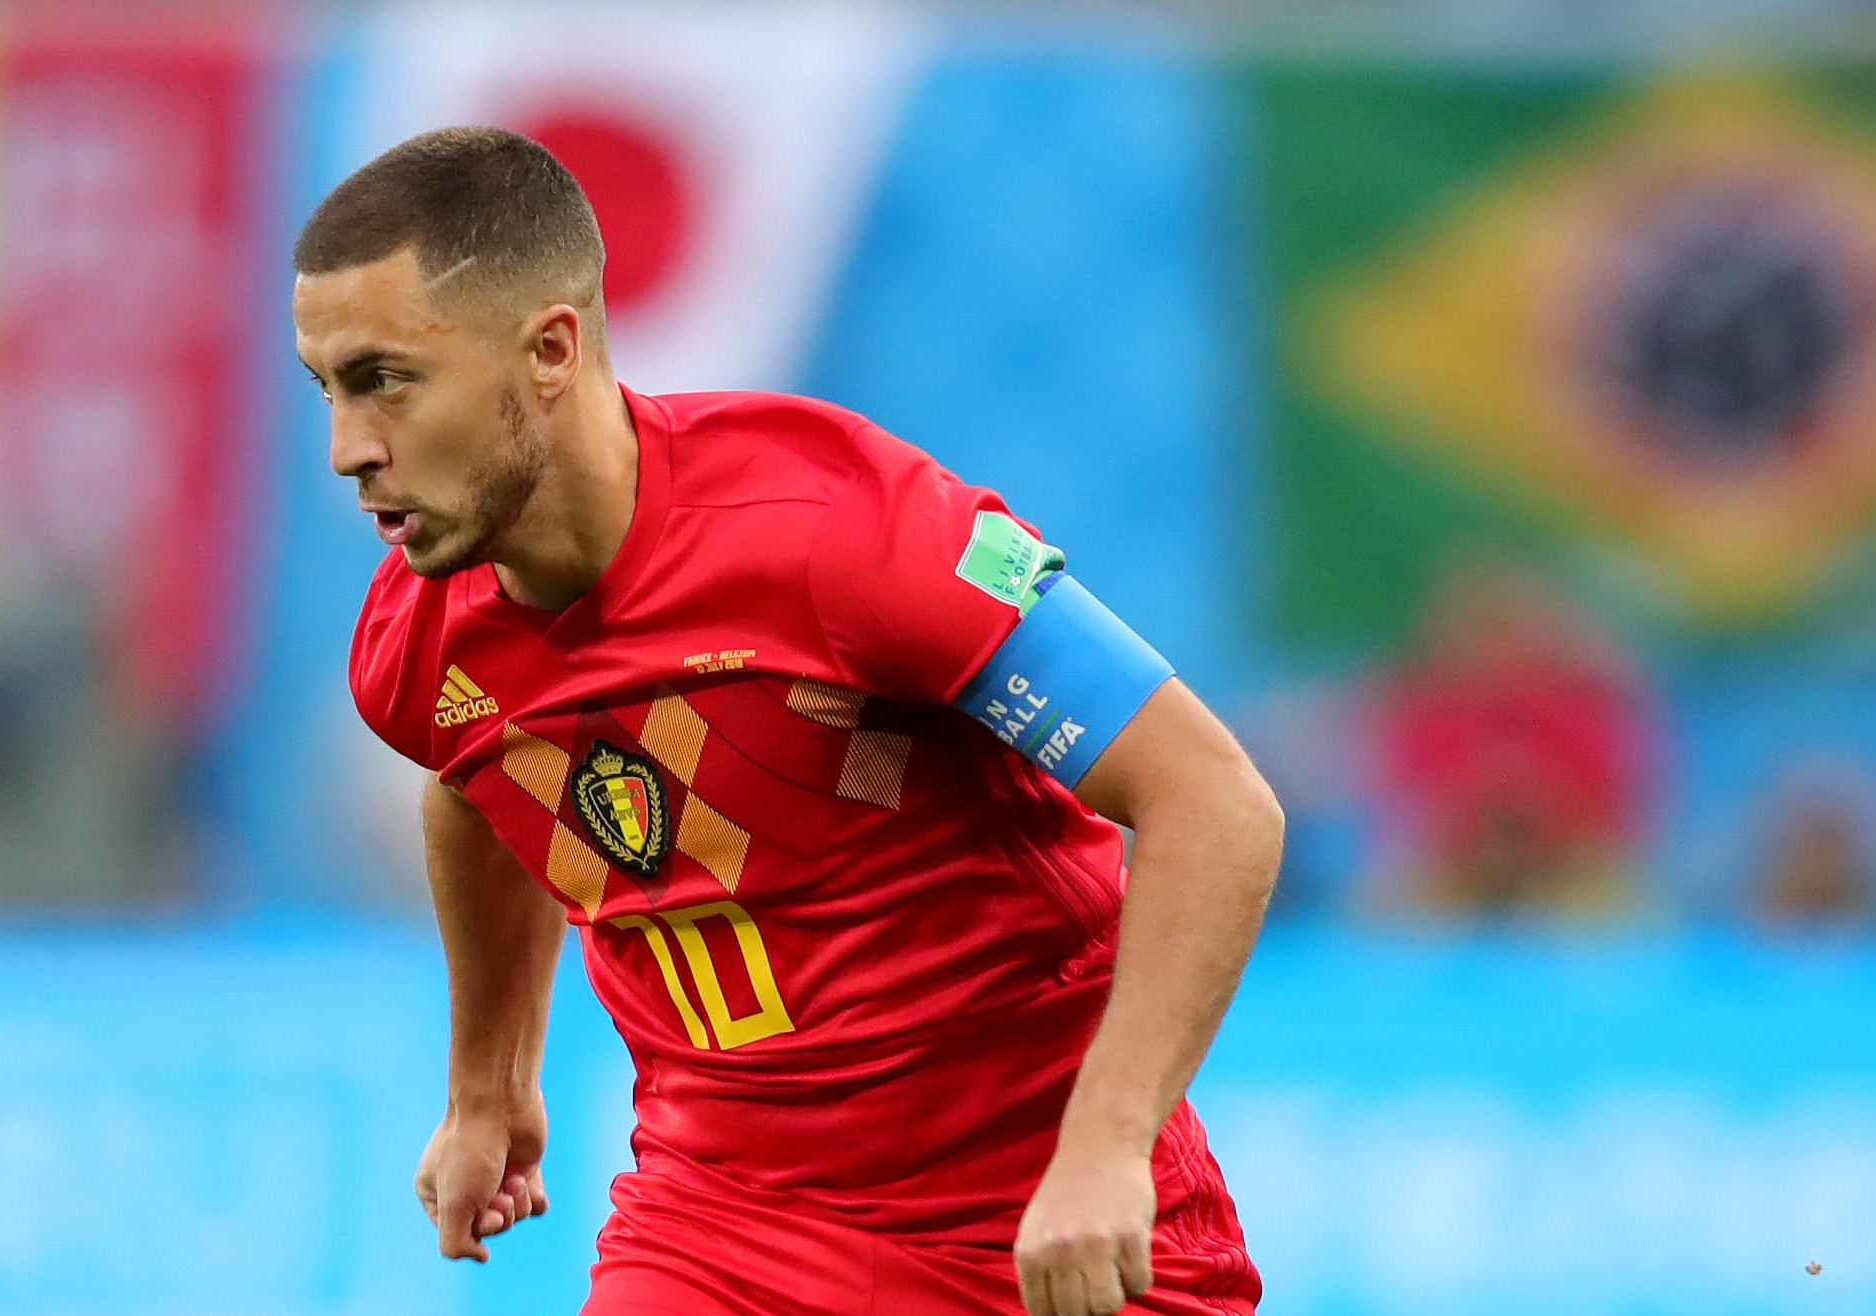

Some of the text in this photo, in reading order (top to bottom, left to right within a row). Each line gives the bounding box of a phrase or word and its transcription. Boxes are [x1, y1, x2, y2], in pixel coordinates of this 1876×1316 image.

[434, 696, 500, 728] adidas
[1036, 719, 1087, 770] FIFA
[606, 900, 797, 1051] 10
